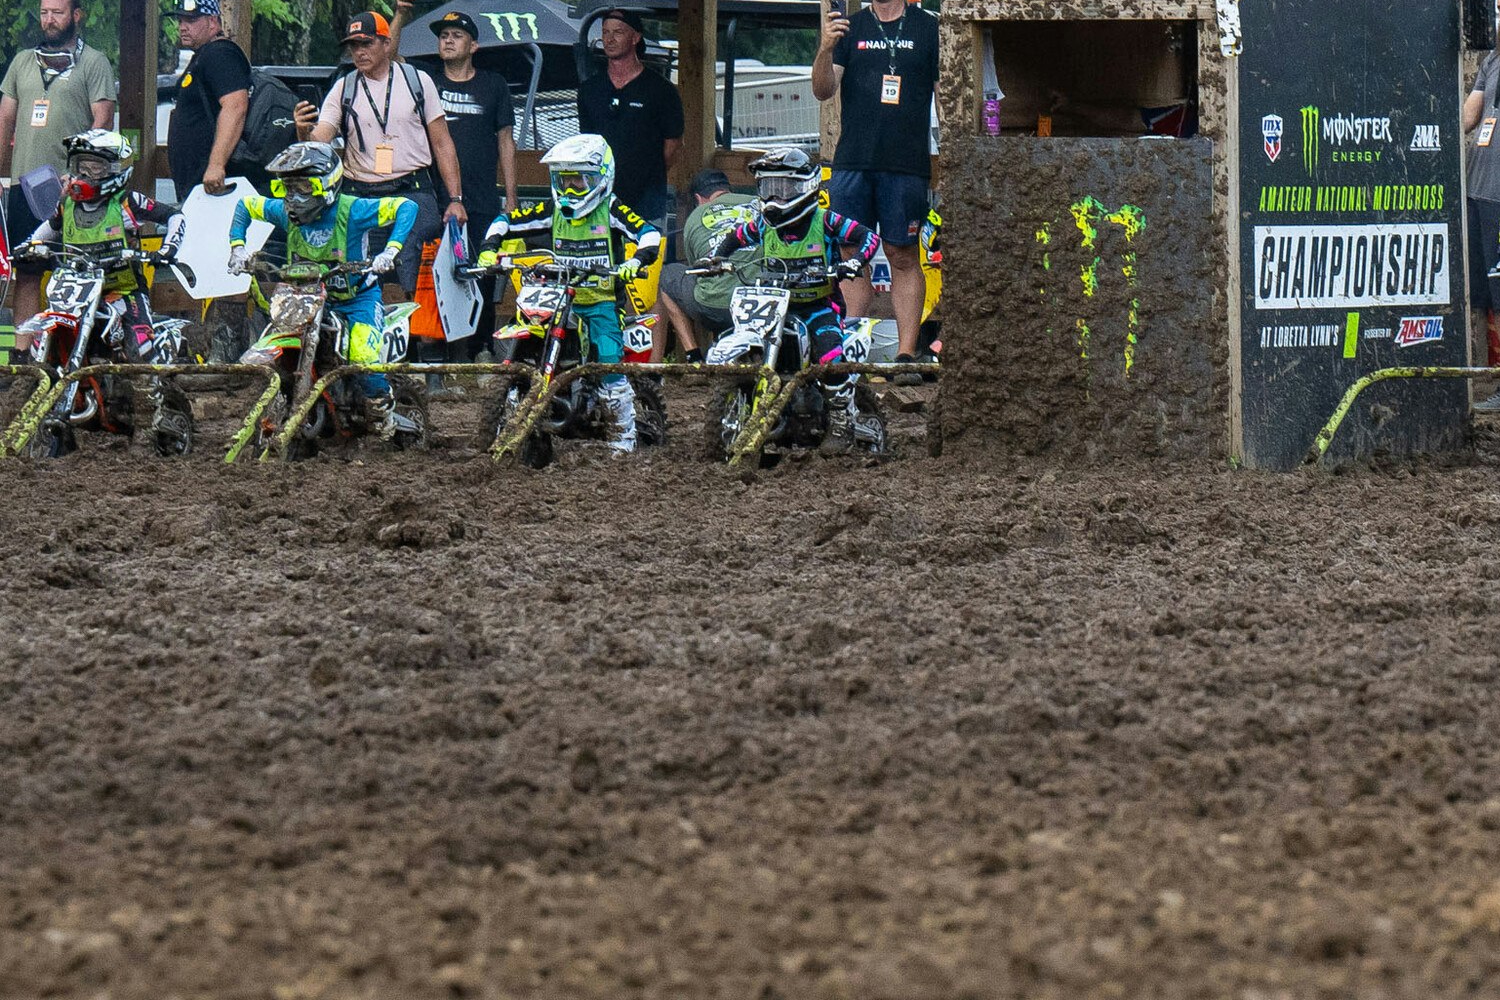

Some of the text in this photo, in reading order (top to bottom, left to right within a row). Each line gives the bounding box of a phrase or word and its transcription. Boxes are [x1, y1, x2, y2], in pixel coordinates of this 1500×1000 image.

[1322, 112, 1393, 146] MONSTER
[1332, 151, 1381, 162] ENERGY
[1259, 184, 1445, 212] AMATEUR NATIONAL MOTOCROSS
[1259, 234, 1444, 300] CHAMPIONSHIP
[49, 278, 96, 304] 51
[523, 288, 562, 309] 42
[737, 299, 779, 326] 34
[382, 326, 406, 362] 26
[629, 328, 651, 347] 42
[1260, 325, 1339, 348] AT LORETTA LYNN'S
[1400, 319, 1444, 344] AMSOIL
[845, 338, 867, 362] 34
